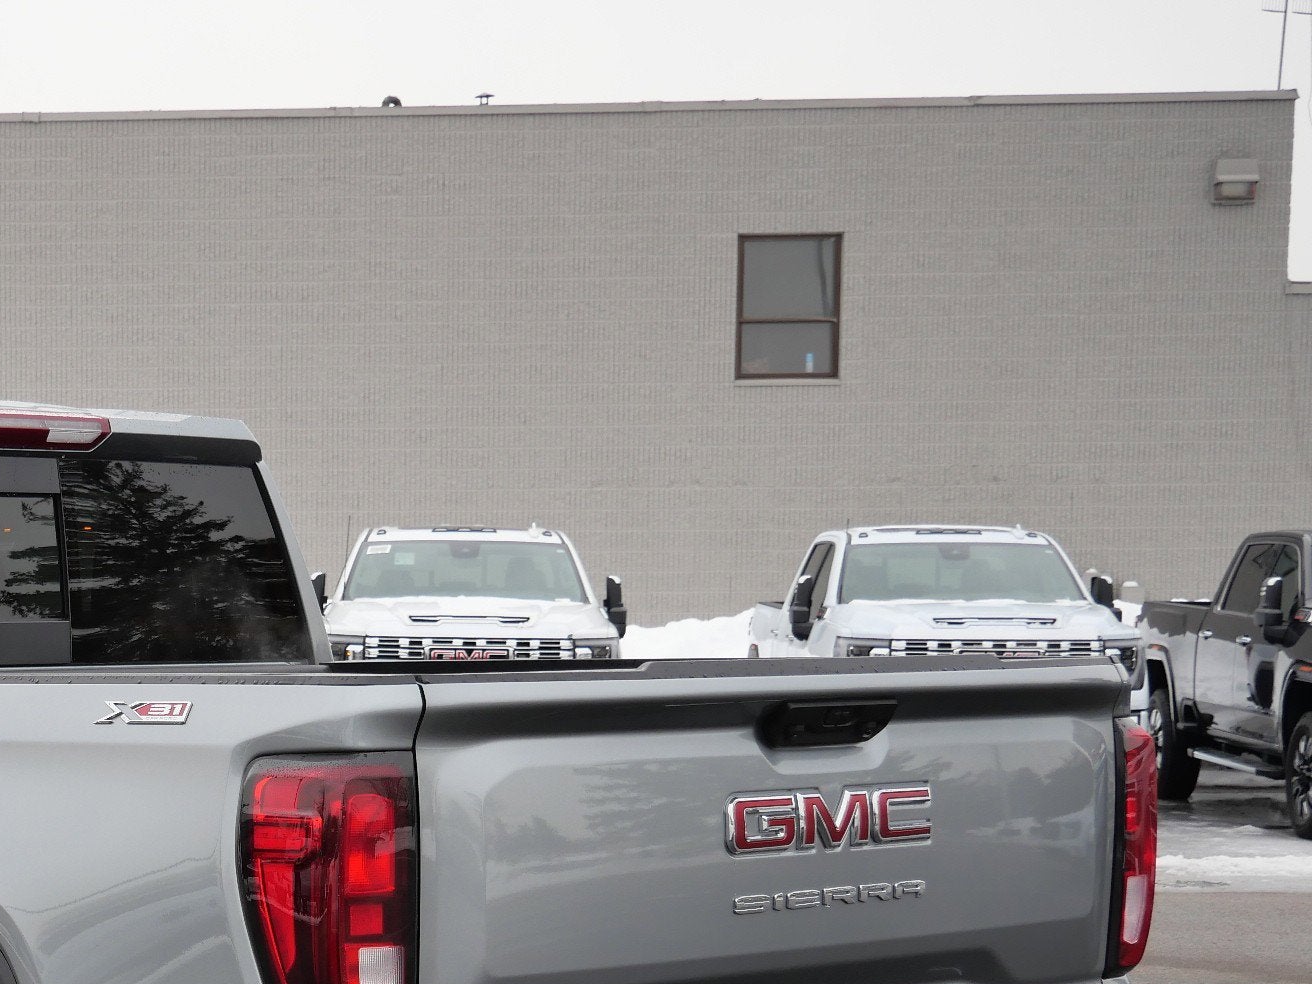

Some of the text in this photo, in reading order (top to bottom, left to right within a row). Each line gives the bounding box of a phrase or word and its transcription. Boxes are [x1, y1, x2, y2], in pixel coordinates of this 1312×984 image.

[92, 701, 193, 725] X31
[725, 786, 931, 857] GMC
[733, 879, 926, 915] SIERRA
